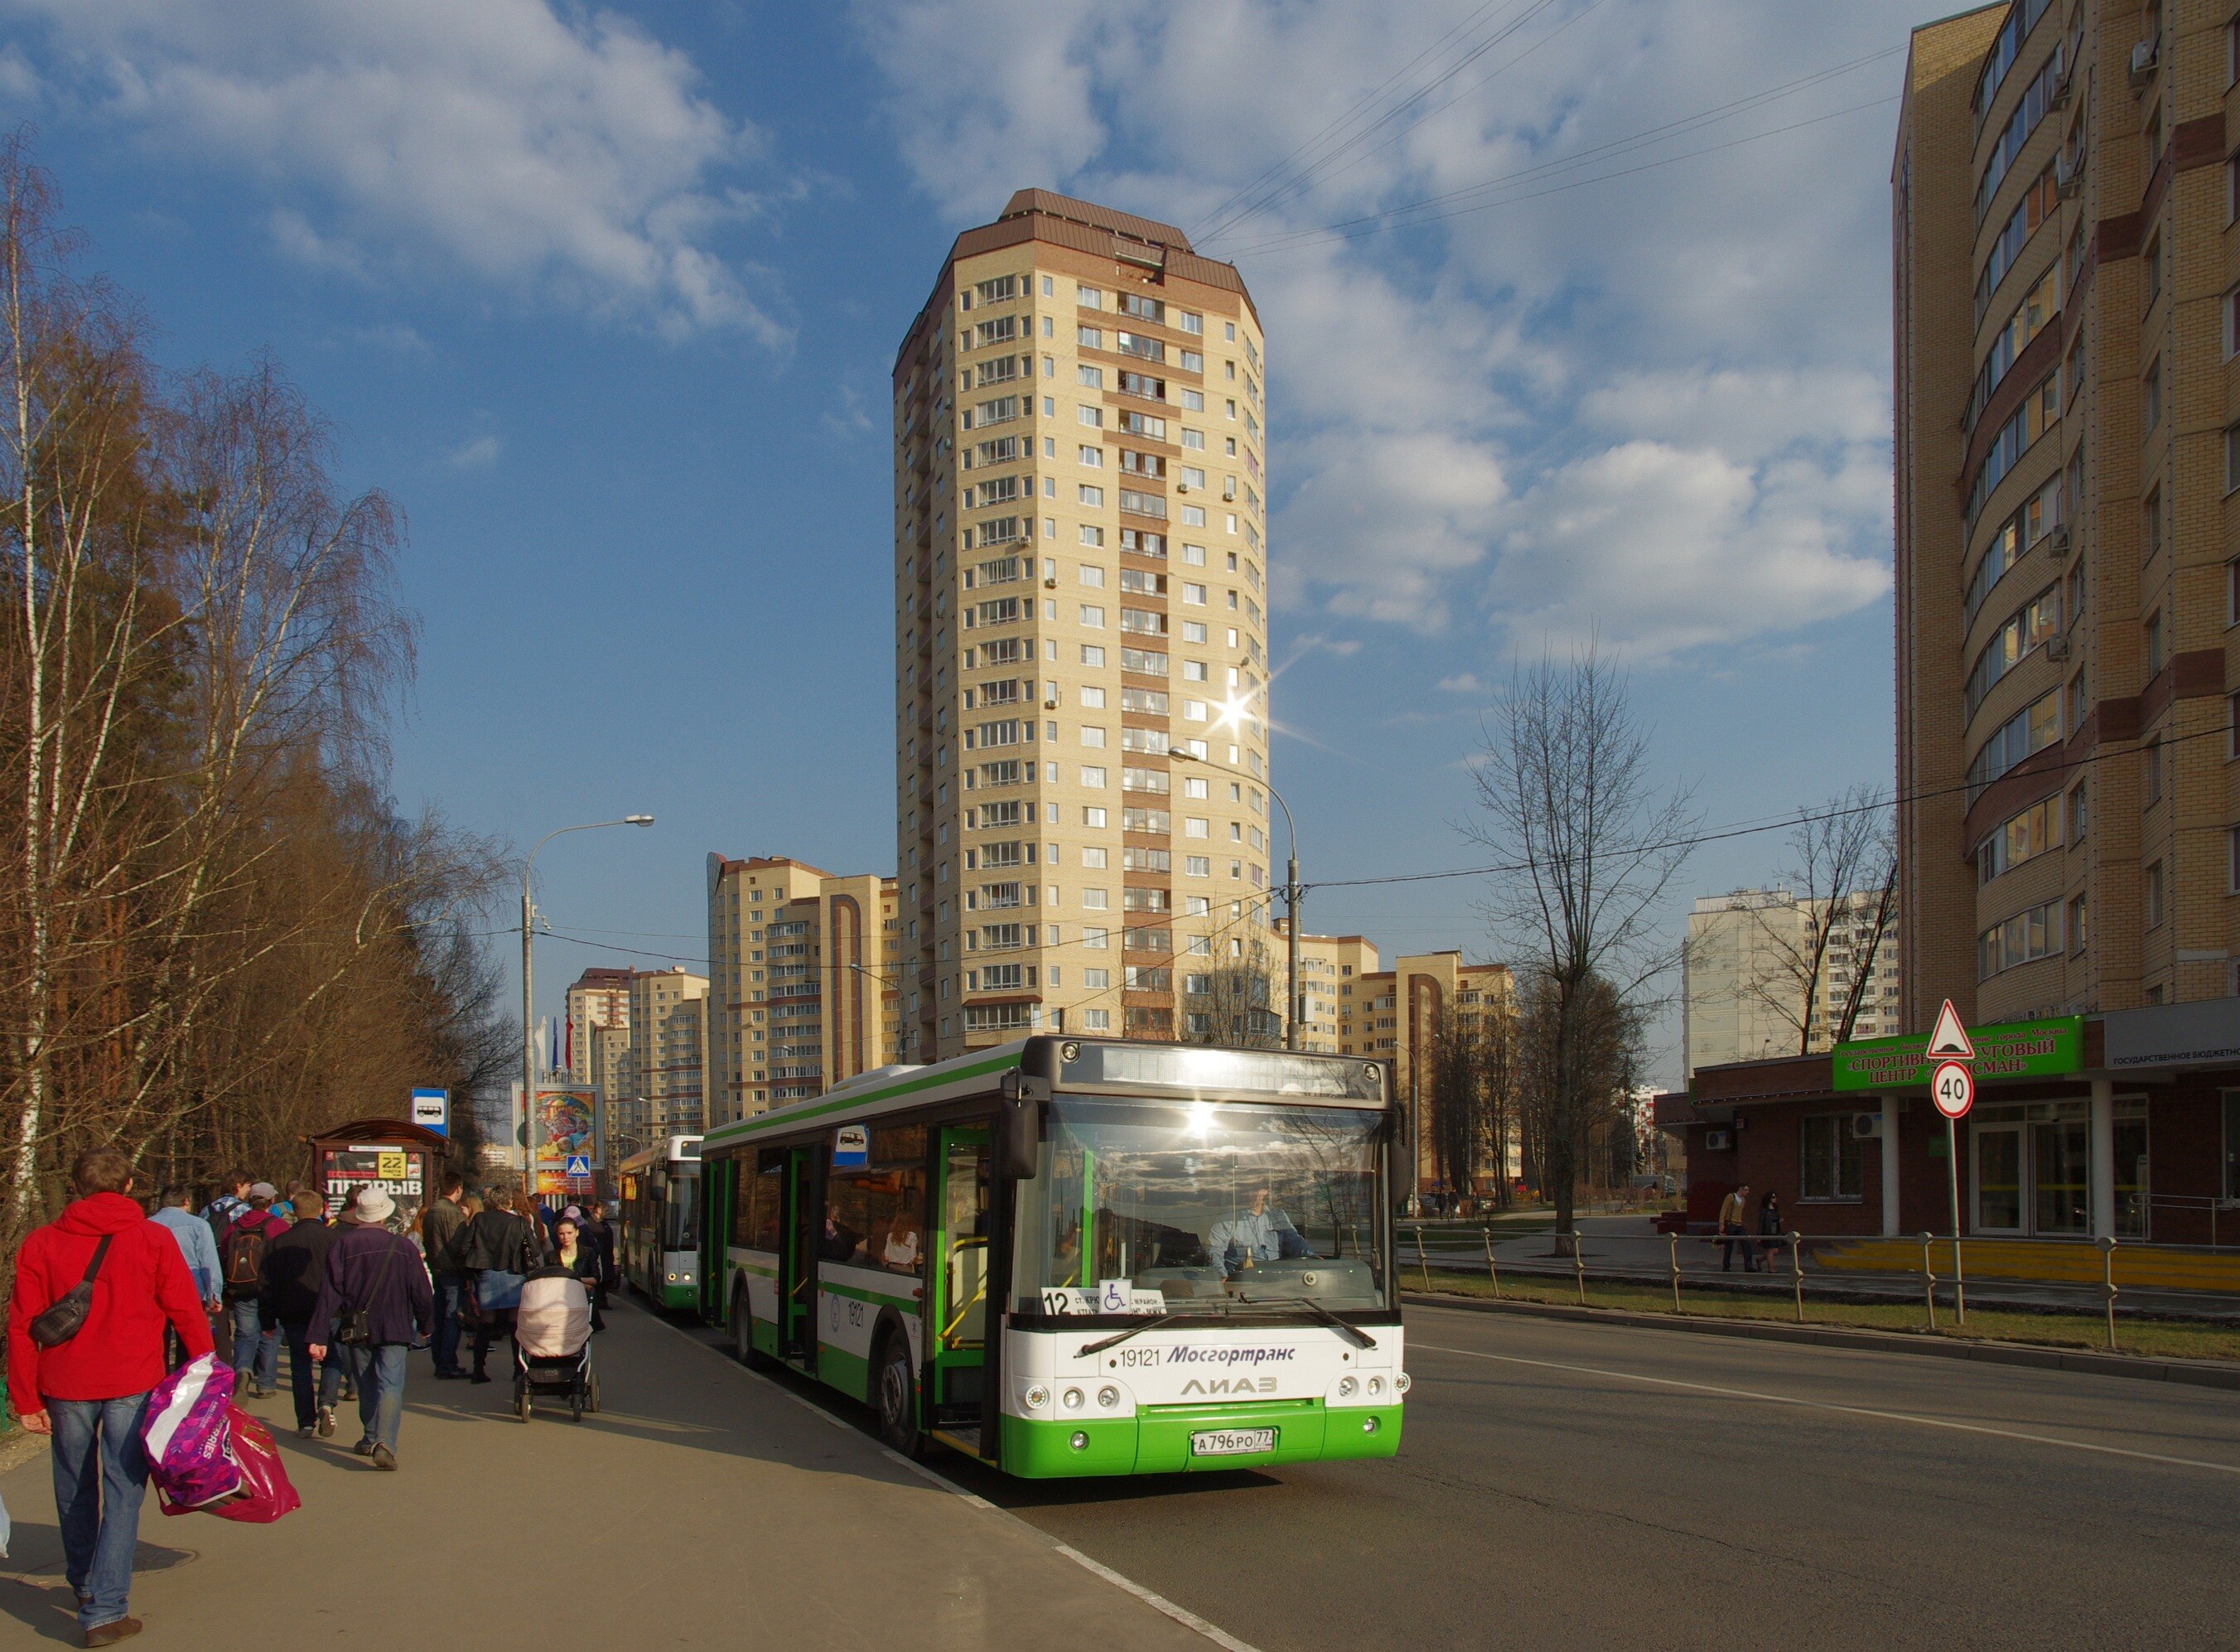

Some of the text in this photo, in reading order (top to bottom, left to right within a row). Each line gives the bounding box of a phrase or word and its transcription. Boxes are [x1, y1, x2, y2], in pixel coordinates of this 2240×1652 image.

[1996, 1032, 2026, 1041] города
[2031, 1027, 2068, 1037] Москвы
[2113, 1051, 2191, 1065] ГОСУДАРСТВЕННОЕ
[1870, 1068, 1917, 1084] ЦЕНТР
[1940, 1078, 1964, 1100] 40
[382, 1157, 402, 1168] 22
[1044, 1292, 1071, 1316] 12
[848, 1300, 864, 1328] 19121
[1119, 1349, 1160, 1367] 19121
[1166, 1345, 1296, 1367] Мосгортранс
[1180, 1377, 1277, 1395] ЛИАЗ
